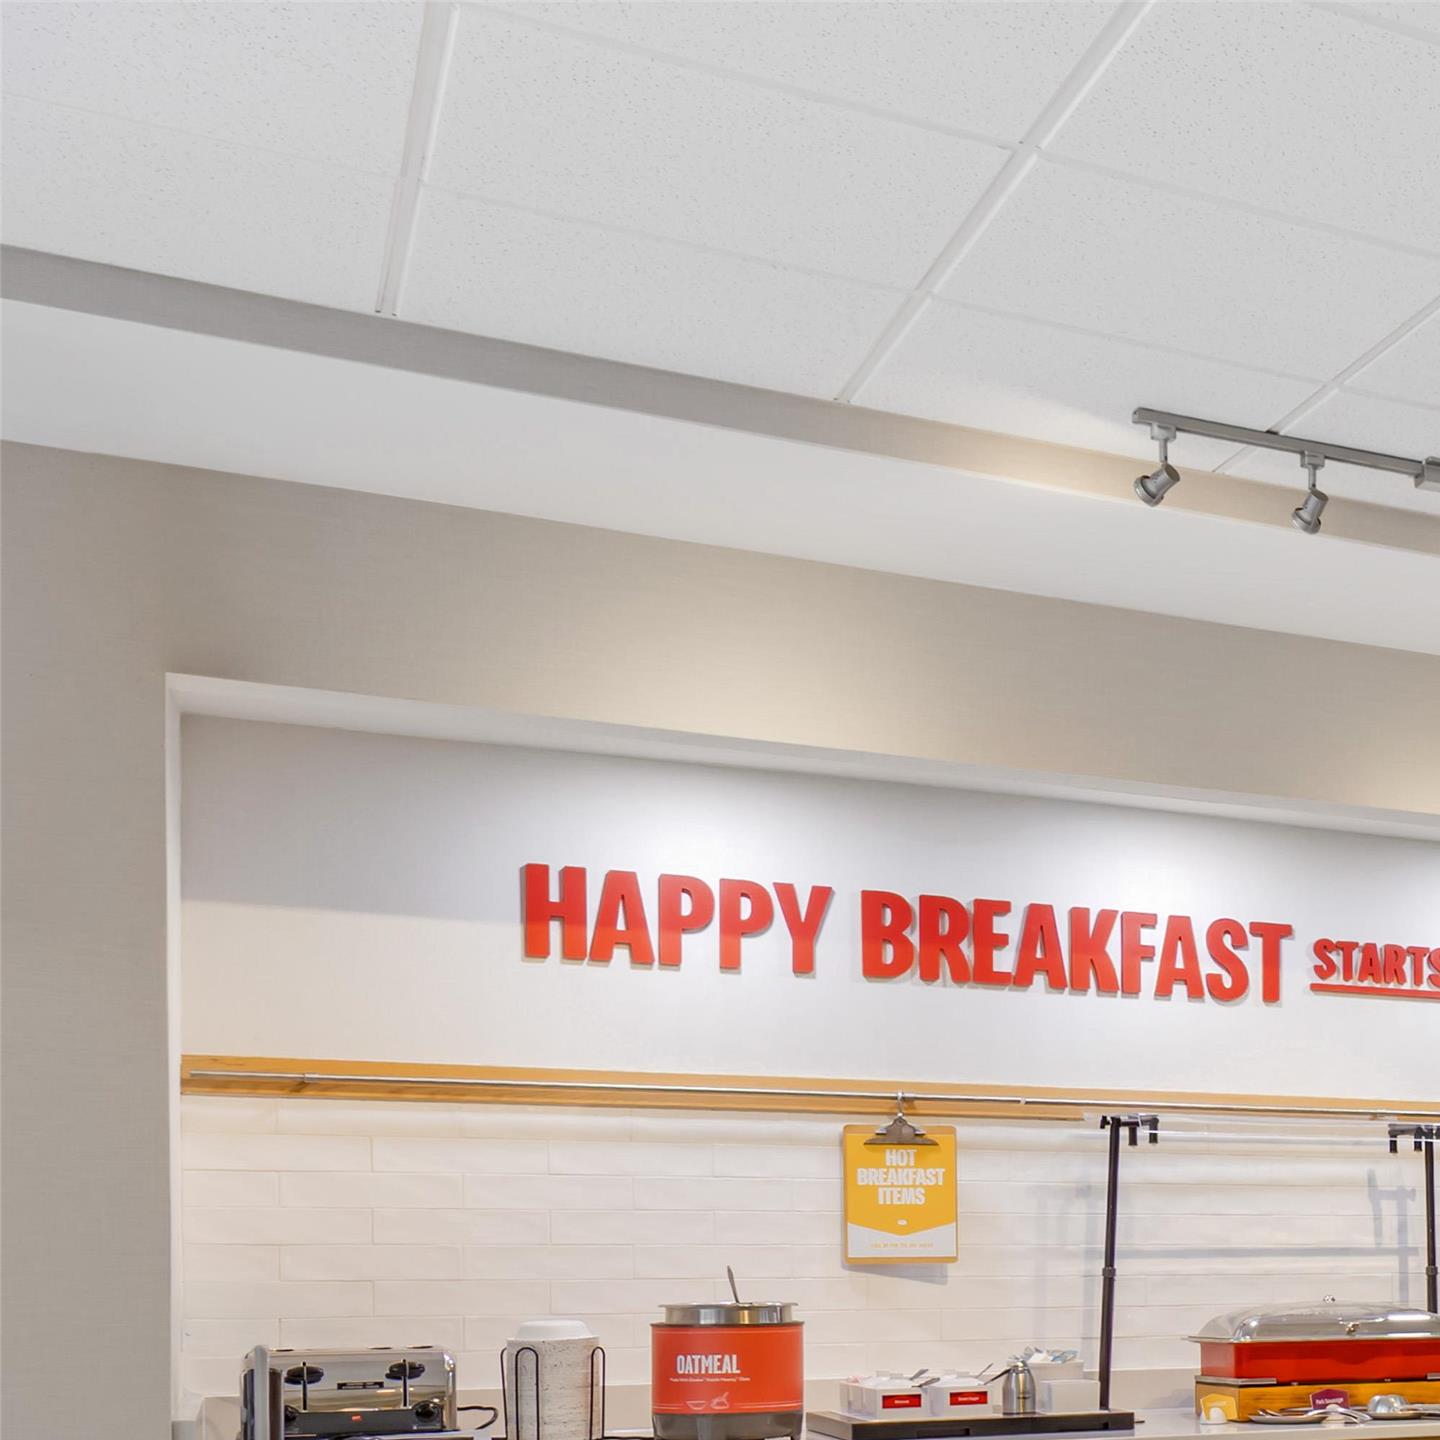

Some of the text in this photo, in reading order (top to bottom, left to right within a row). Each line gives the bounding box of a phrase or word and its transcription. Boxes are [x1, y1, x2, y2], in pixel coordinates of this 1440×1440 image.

[521, 863, 834, 977] HAPPY
[861, 889, 1294, 1004] BREAKFAST
[885, 1149, 917, 1166] HOT
[857, 1168, 945, 1185] BREAKFAST
[878, 1187, 926, 1205] ITEMS
[676, 1354, 741, 1375] OATMEAL
